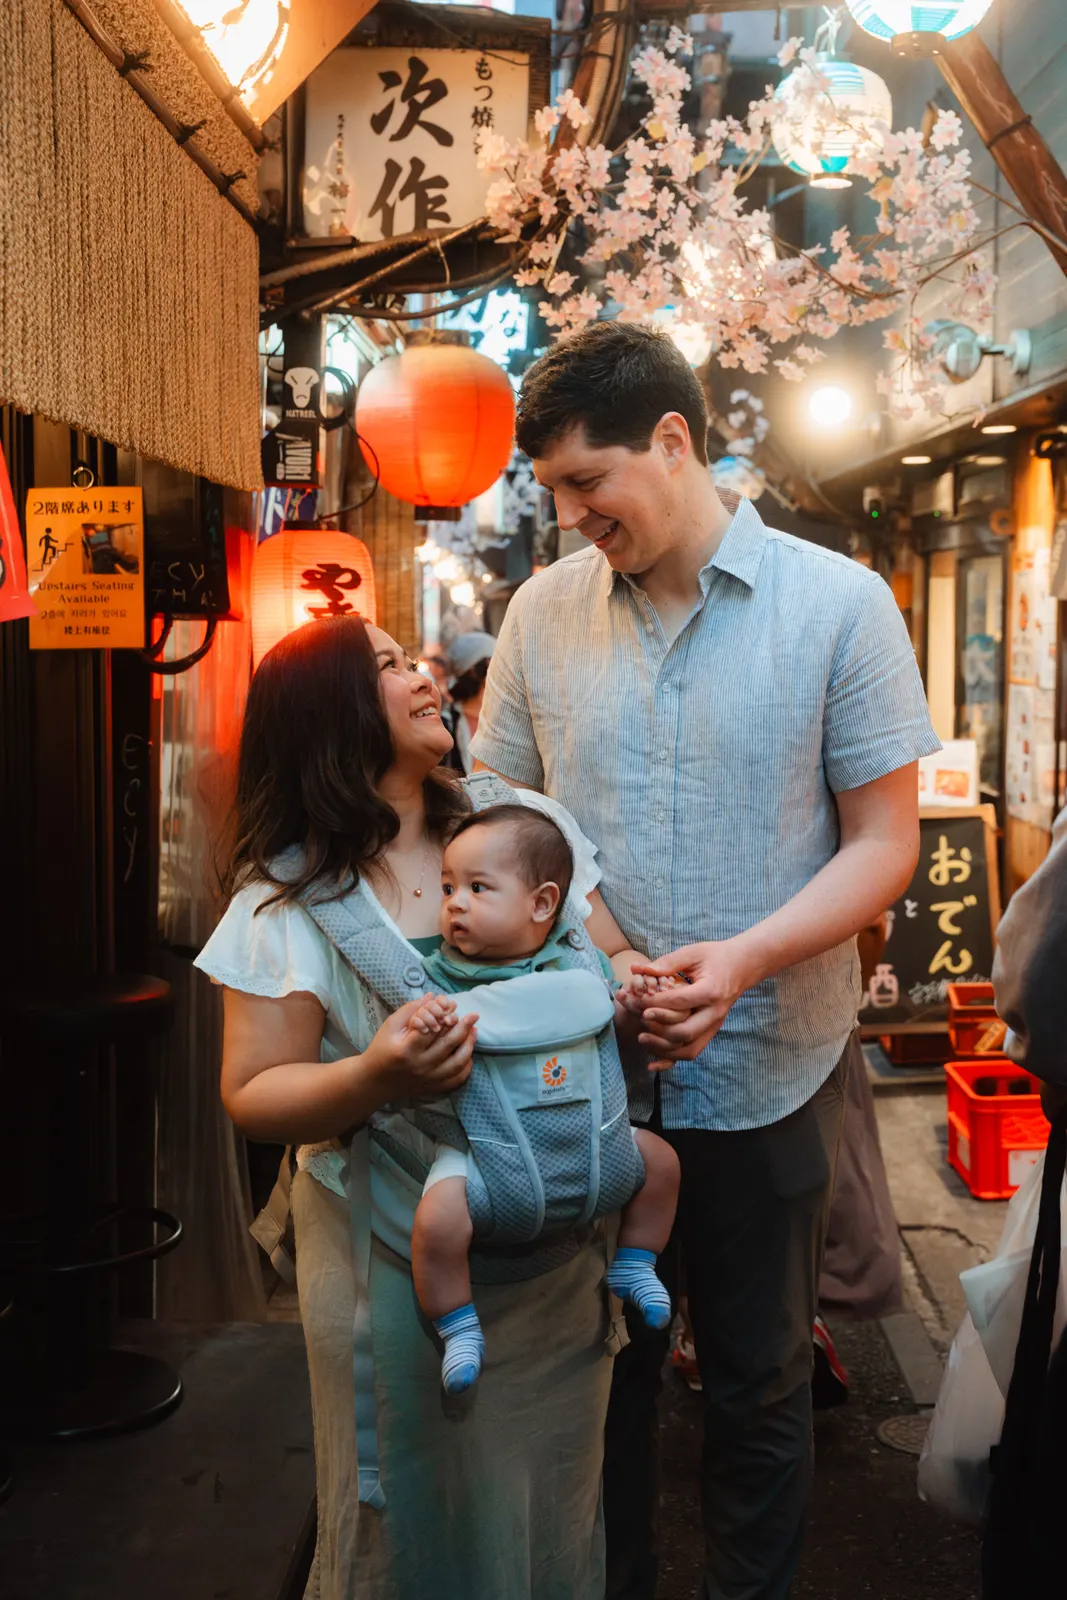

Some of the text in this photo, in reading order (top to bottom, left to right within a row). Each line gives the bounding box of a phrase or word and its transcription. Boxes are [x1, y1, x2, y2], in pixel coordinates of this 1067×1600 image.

[367, 56, 454, 239] 次作
[33, 501, 135, 515] 2階席あります
[39, 581, 135, 591] Upstairs Seating
[58, 595, 110, 604] Available
[904, 899, 919, 919] と
[929, 835, 977, 975] おでん
